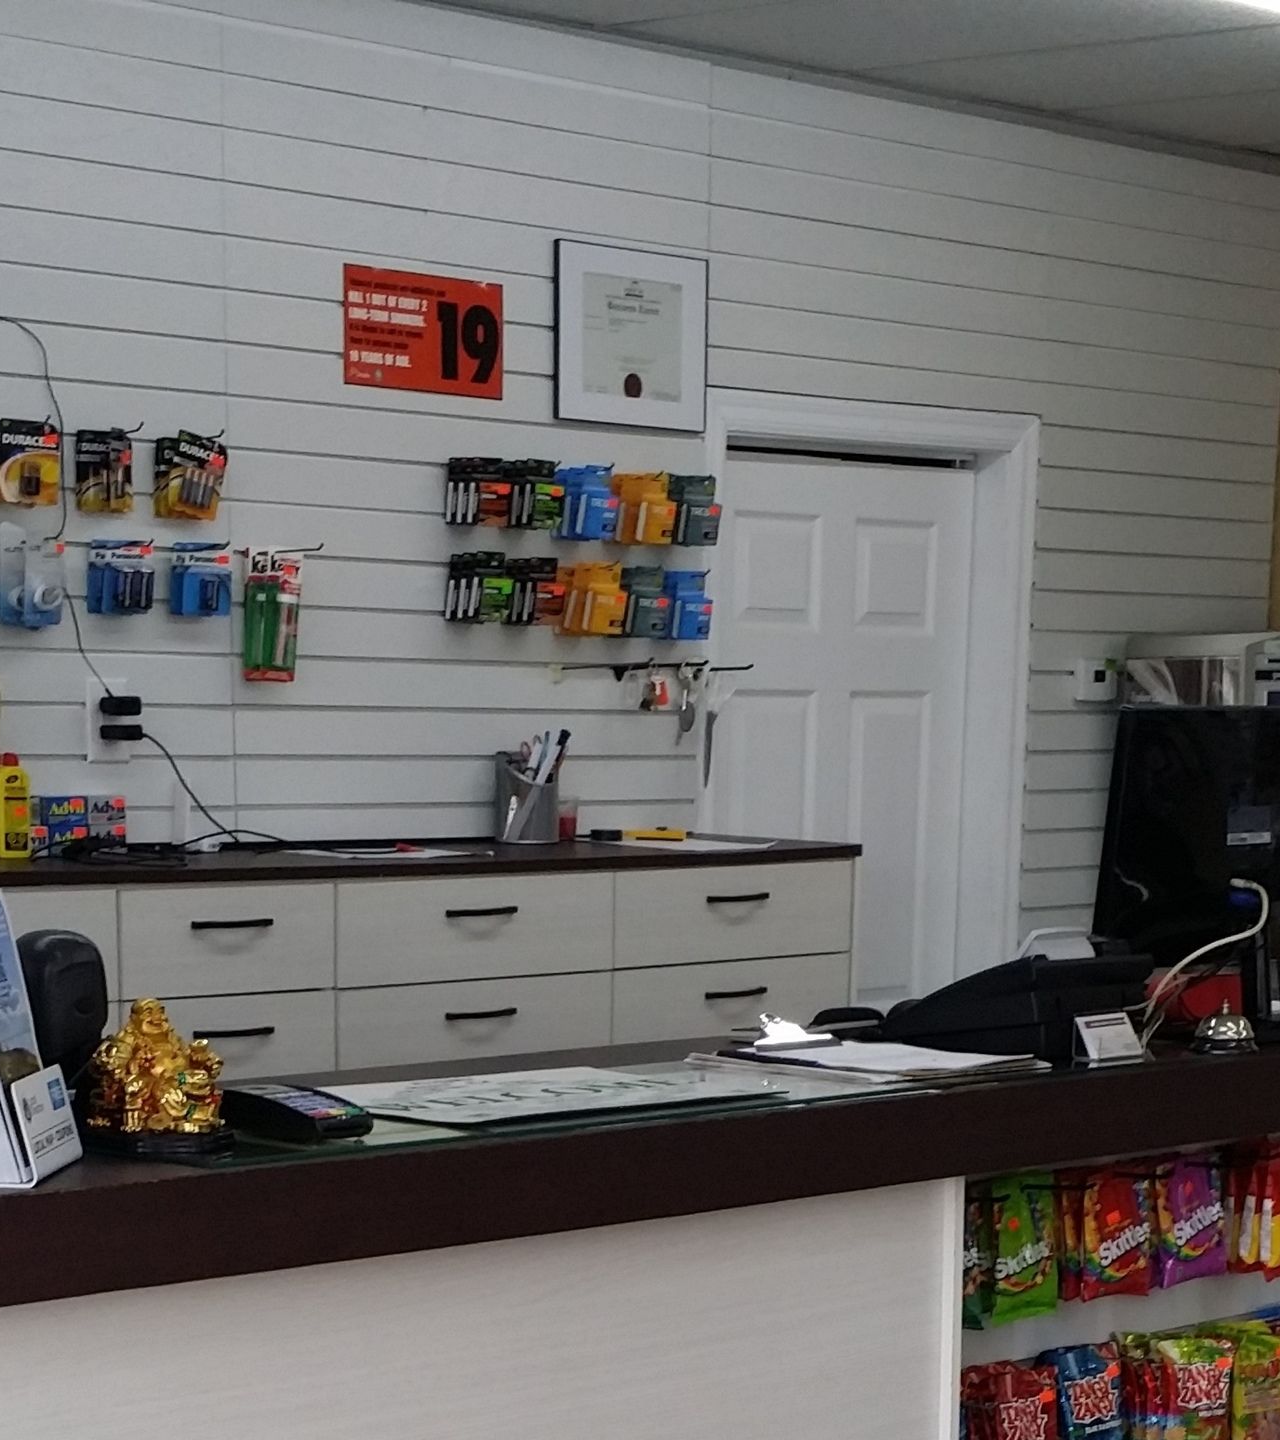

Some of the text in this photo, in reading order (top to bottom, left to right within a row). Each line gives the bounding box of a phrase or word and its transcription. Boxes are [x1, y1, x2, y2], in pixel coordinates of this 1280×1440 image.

[436, 301, 499, 384] 19
[1099, 1221, 1151, 1269] Skittles
[1173, 1202, 1224, 1247] Skittles
[994, 1240, 1051, 1281] Skittles
